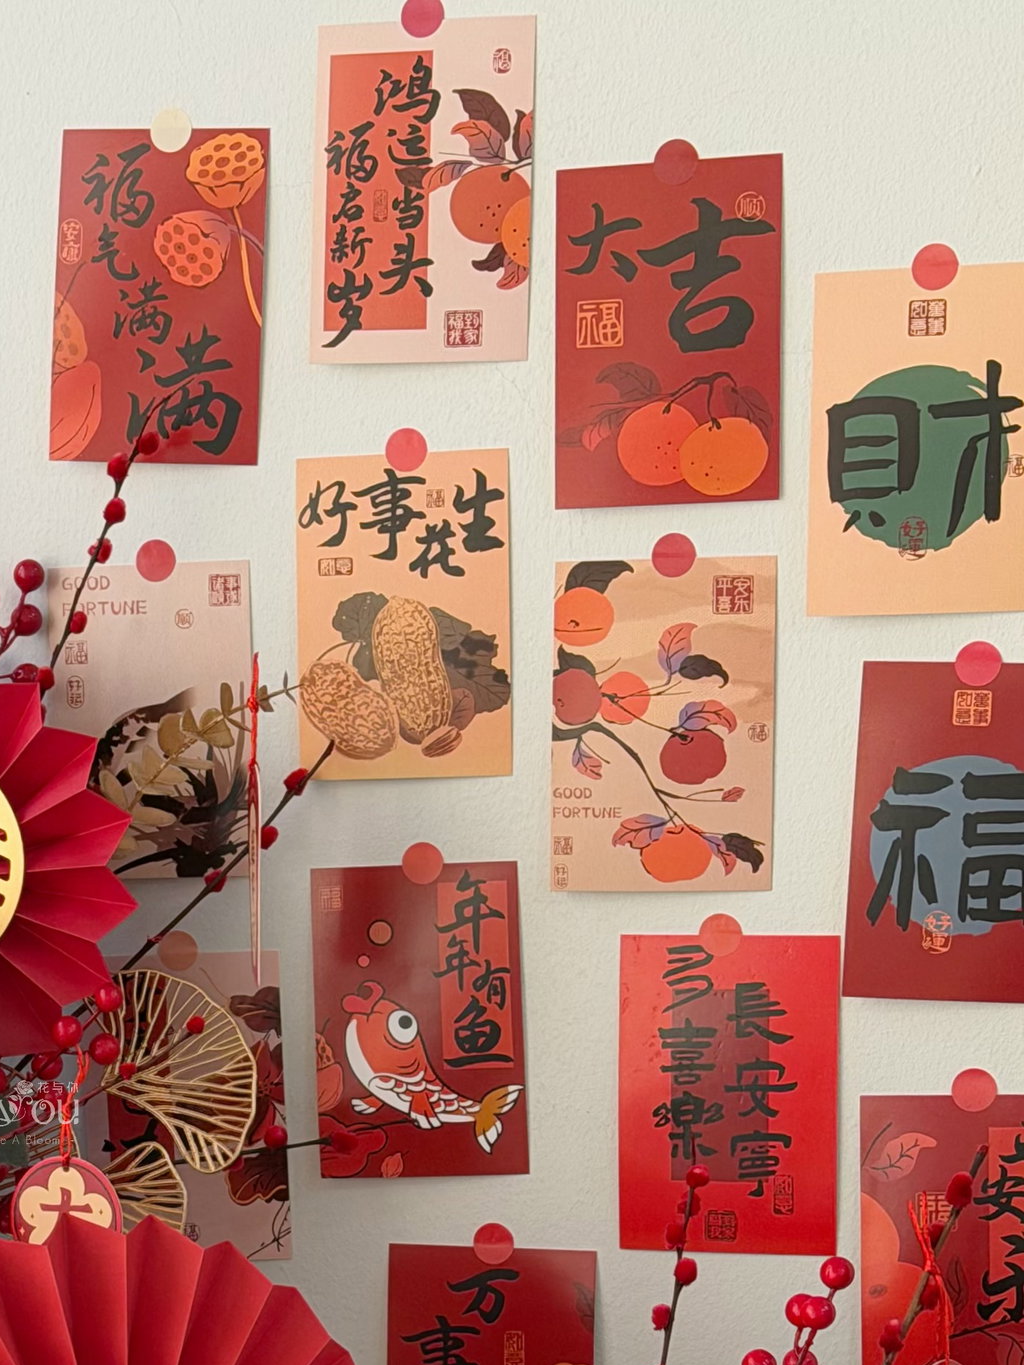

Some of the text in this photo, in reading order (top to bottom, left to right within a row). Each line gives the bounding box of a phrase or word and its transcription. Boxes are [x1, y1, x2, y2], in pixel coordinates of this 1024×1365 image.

[322, 122, 378, 349] 福启新岁
[374, 56, 441, 298] 鸿运当头
[81, 143, 243, 456] 福气满满
[565, 198, 776, 353] 大吉
[576, 299, 624, 349] 福
[297, 468, 505, 579] 好事花生
[552, 787, 593, 801] GOOD
[552, 806, 622, 820] FORTUNE
[866, 766, 1024, 932] 福
[432, 868, 514, 1068] 年年有鱼
